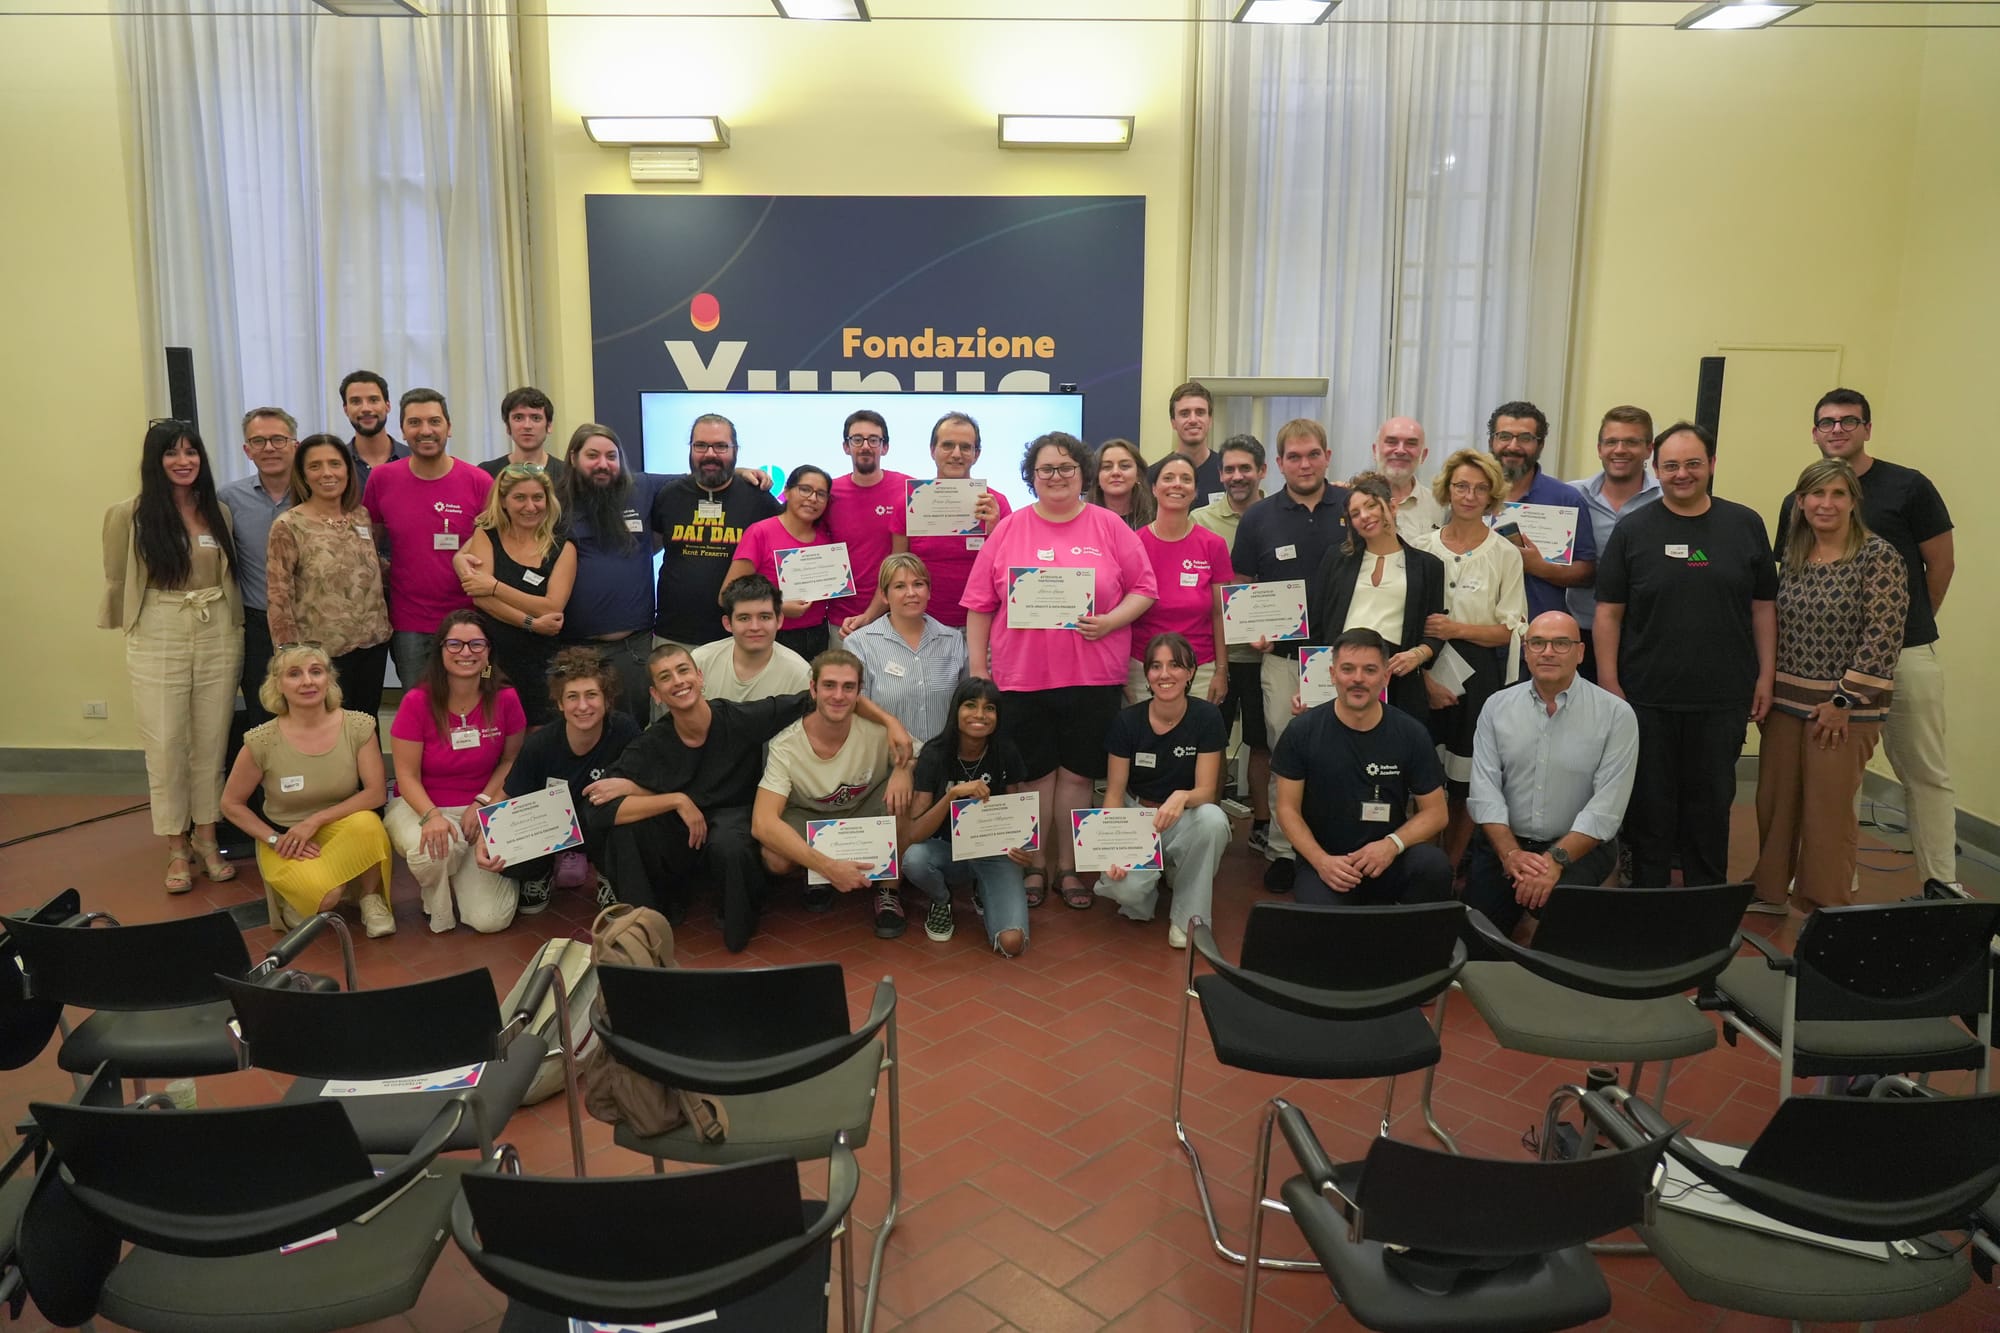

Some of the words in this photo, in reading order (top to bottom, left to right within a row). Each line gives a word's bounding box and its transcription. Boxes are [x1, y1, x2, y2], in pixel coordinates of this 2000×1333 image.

[842, 327, 1056, 358] Fondazione
[672, 525, 704, 542] DAI
[711, 527, 743, 544] DAI
